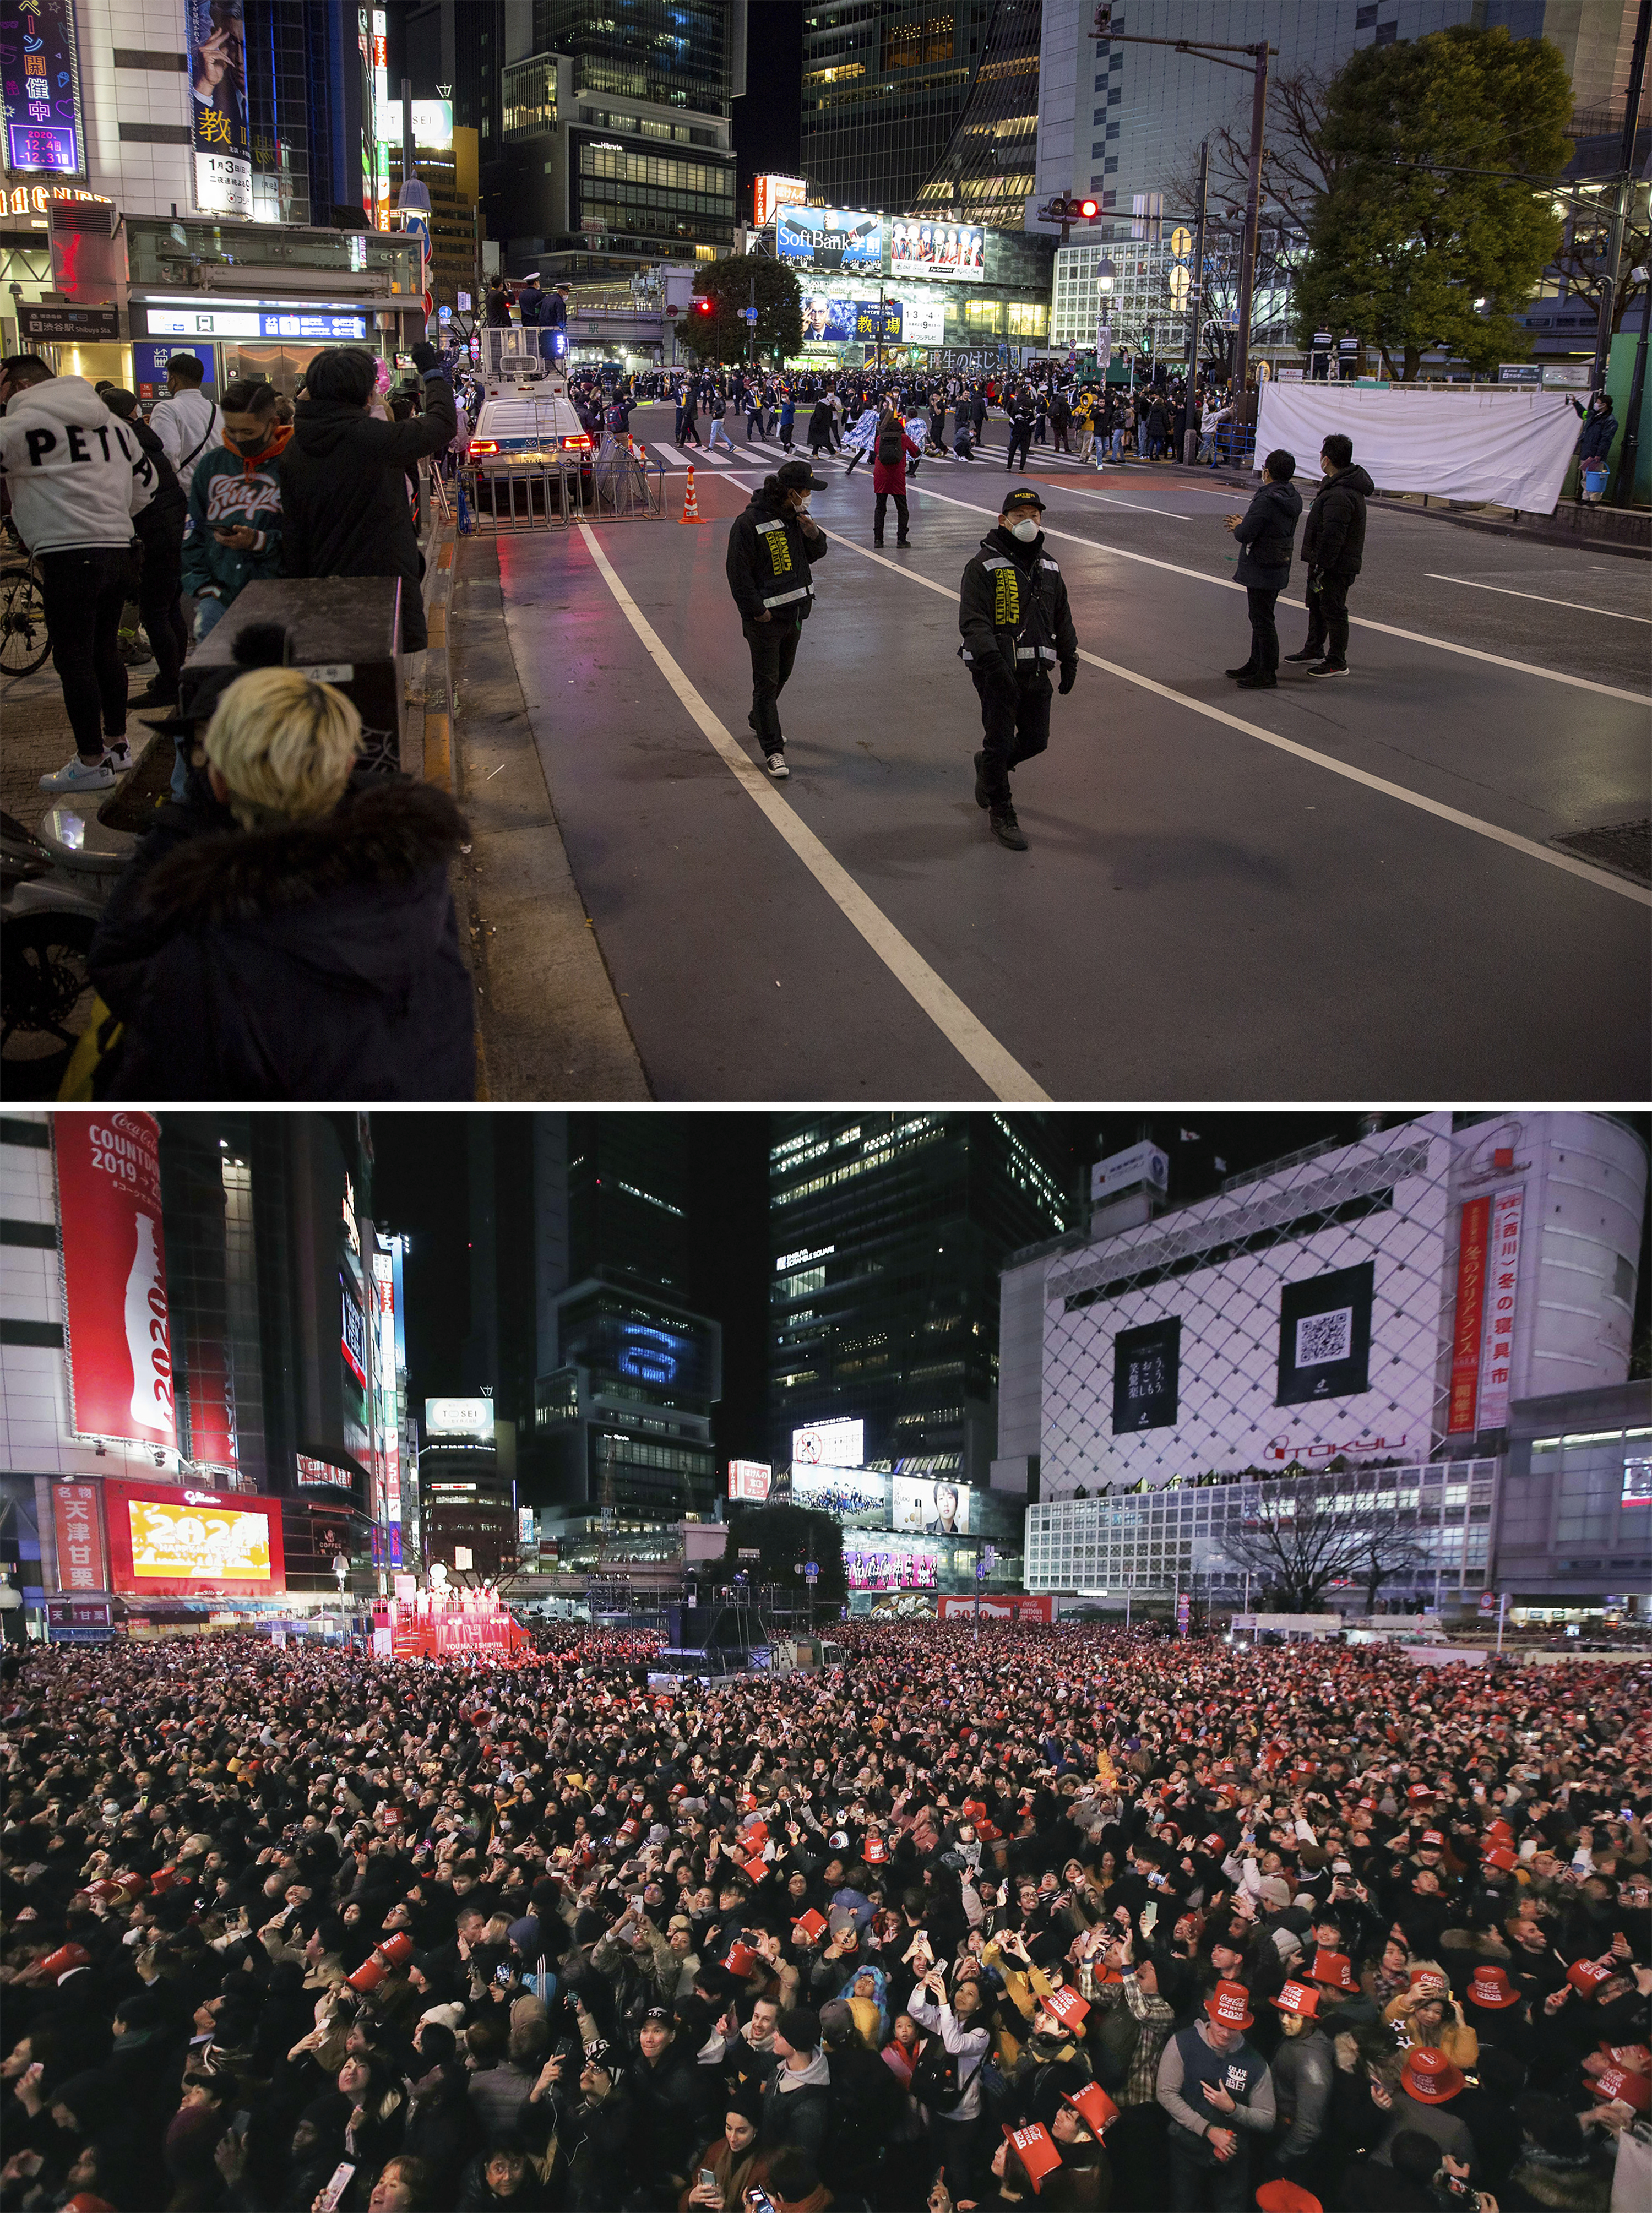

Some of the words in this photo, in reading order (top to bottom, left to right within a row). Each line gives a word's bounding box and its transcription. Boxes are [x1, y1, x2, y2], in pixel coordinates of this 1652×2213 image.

[198, 107, 233, 144] 教
[389, 116, 432, 124] TSEI
[779, 226, 851, 251] SoftBank
[852, 235, 881, 252] 学割
[44, 323, 74, 331] 渋谷駅
[75, 324, 100, 334] Shibuya
[857, 316, 872, 333] 教
[885, 317, 901, 335] 場
[765, 531, 782, 575] SECURITY
[777, 531, 792, 571] BONDS
[994, 568, 1006, 625] SECURITY
[1007, 568, 1019, 624] BONDS
[90, 1147, 137, 1183] 2019
[1285, 1434, 1406, 1459] TOKYU
[745, 1468, 767, 1480] ほけんの
[57, 1487, 93, 1498] 名物
[64, 1500, 95, 1587] 天津甘栗
[1050, 1997, 1067, 2016] 2020
[1219, 1993, 1246, 2007] Coca-Cola
[1278, 1995, 1299, 2008] 2020
[1219, 2008, 1244, 2020] 2020
[1229, 2065, 1248, 2077] BLUE
